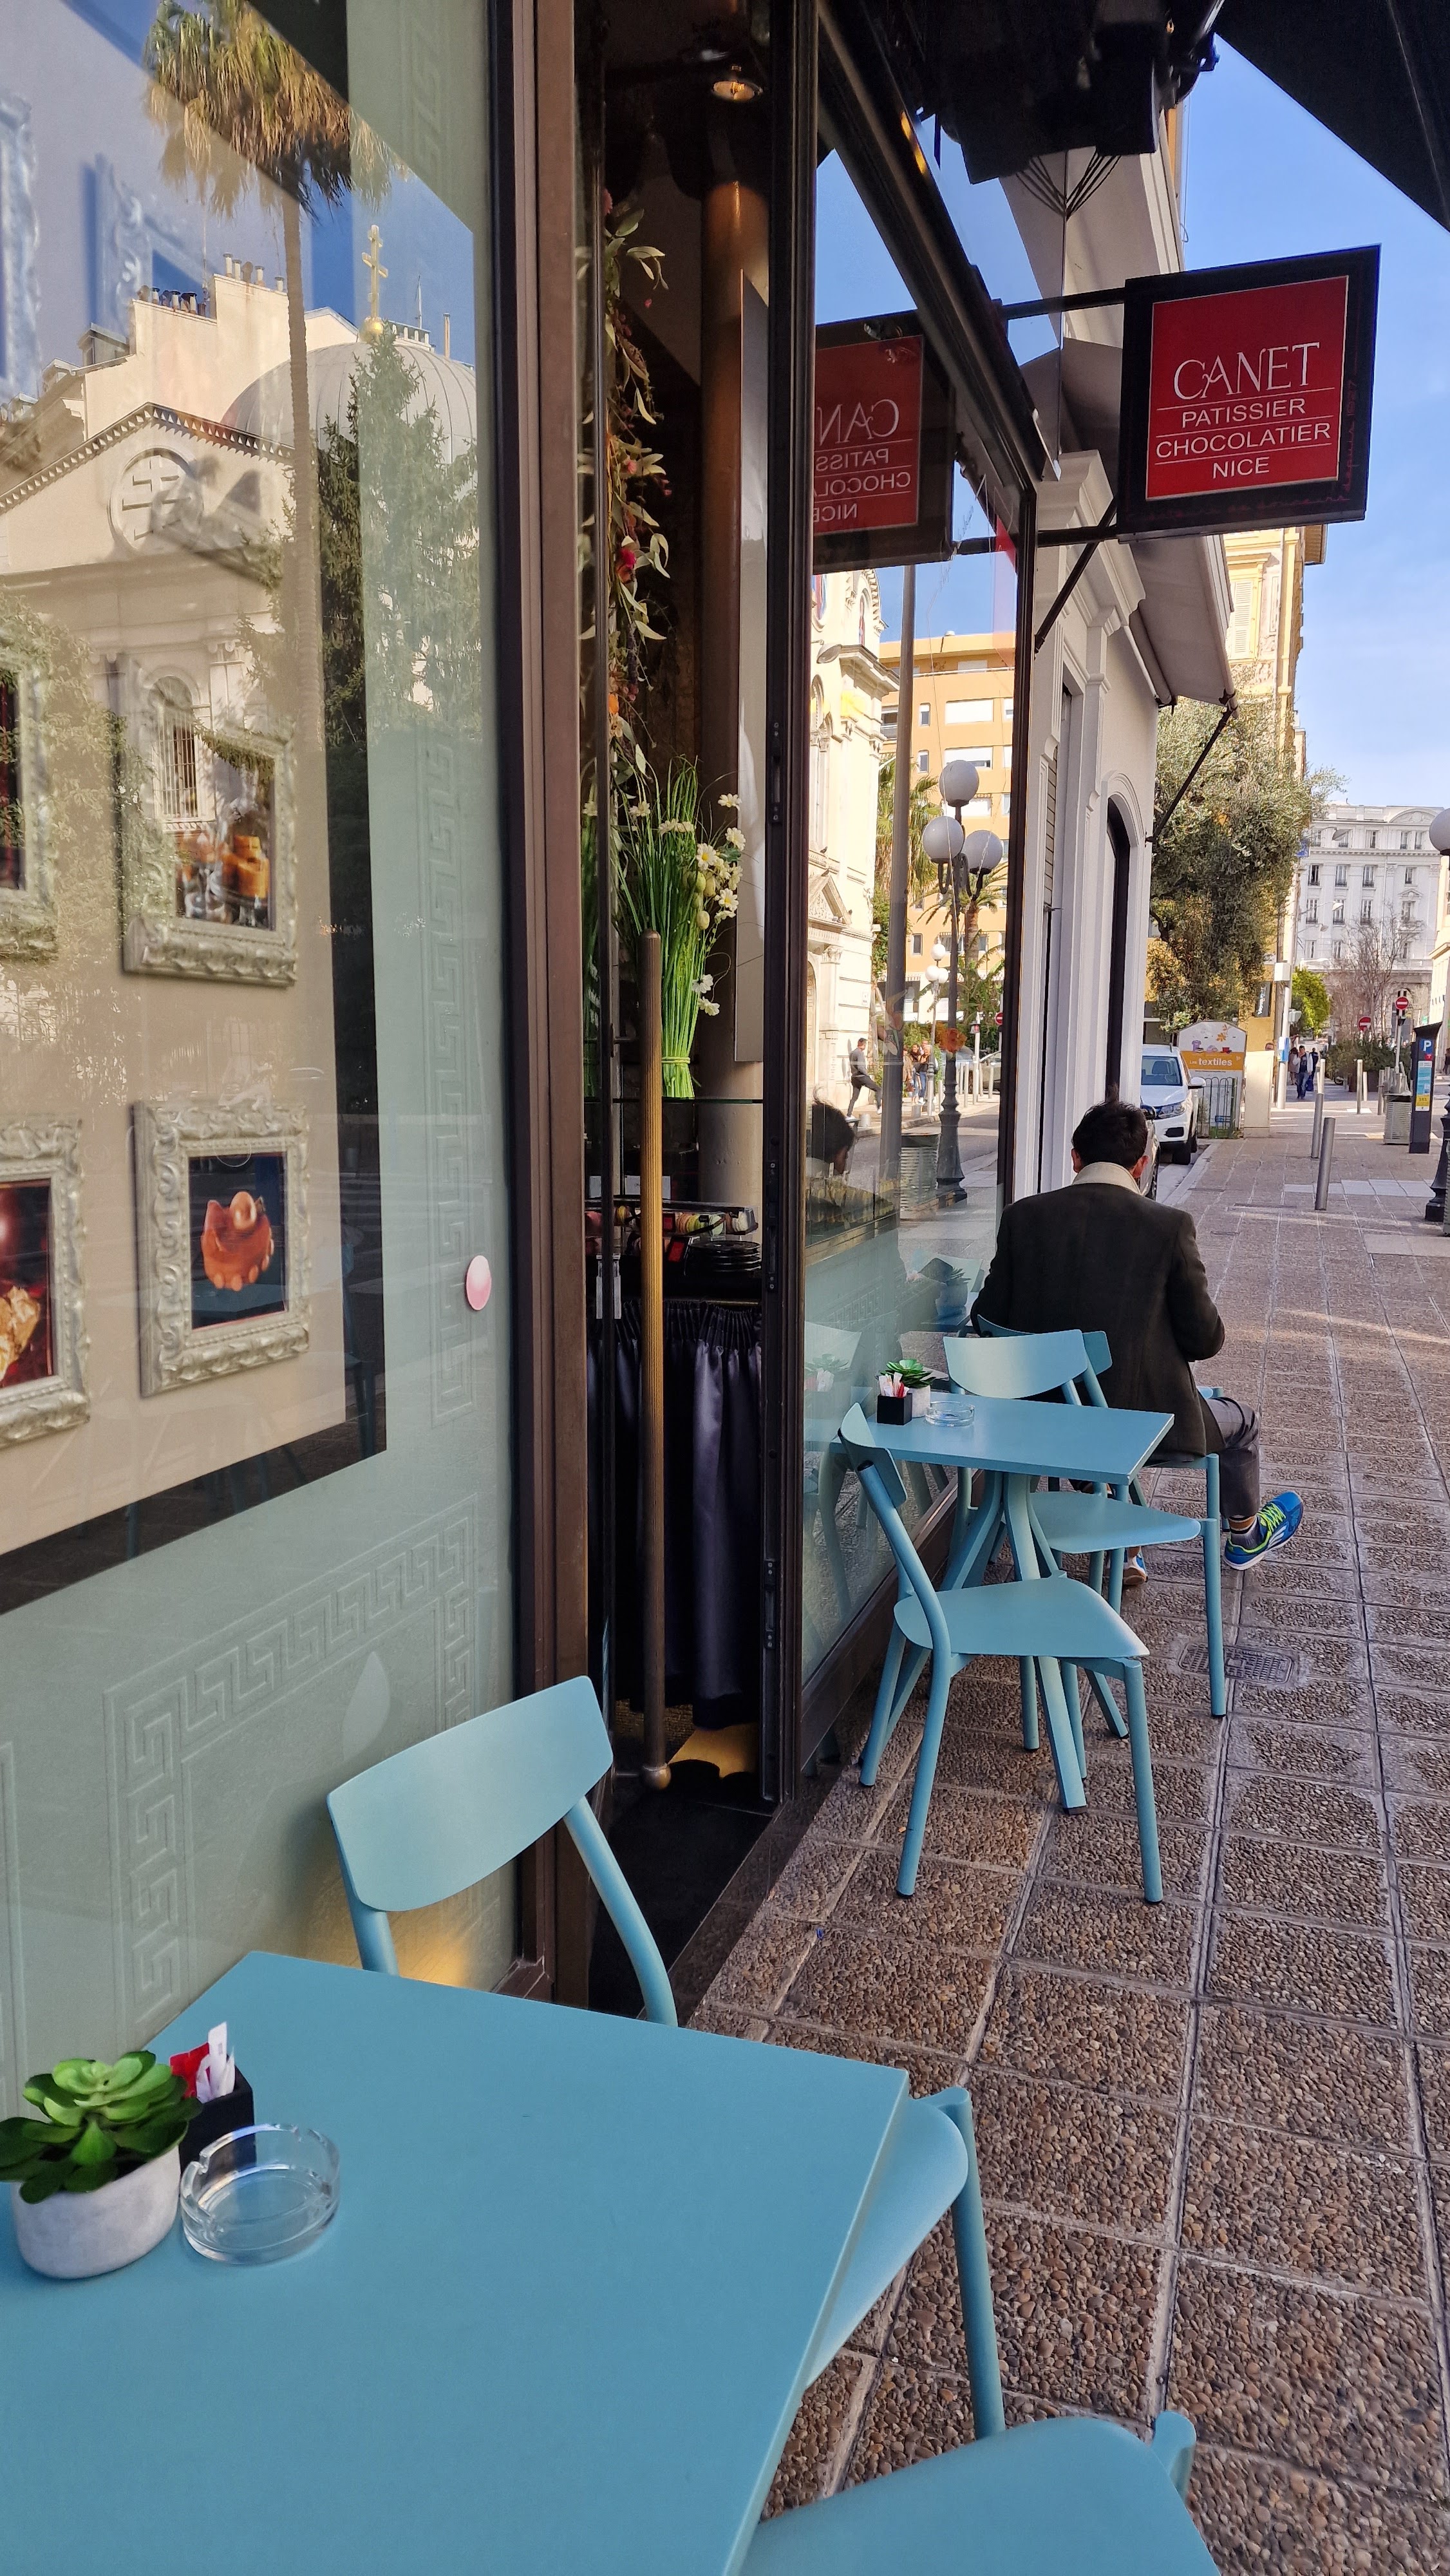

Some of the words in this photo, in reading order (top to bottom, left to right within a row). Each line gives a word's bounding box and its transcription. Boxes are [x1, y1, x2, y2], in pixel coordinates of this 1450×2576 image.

[1174, 342, 1319, 400] CANET
[1182, 398, 1306, 428] PATISSIER
[1156, 422, 1331, 458] CHOCOLATIER
[1213, 457, 1270, 478] NICE
[1423, 1040, 1431, 1051] P
[1199, 1057, 1232, 1066] textiles
